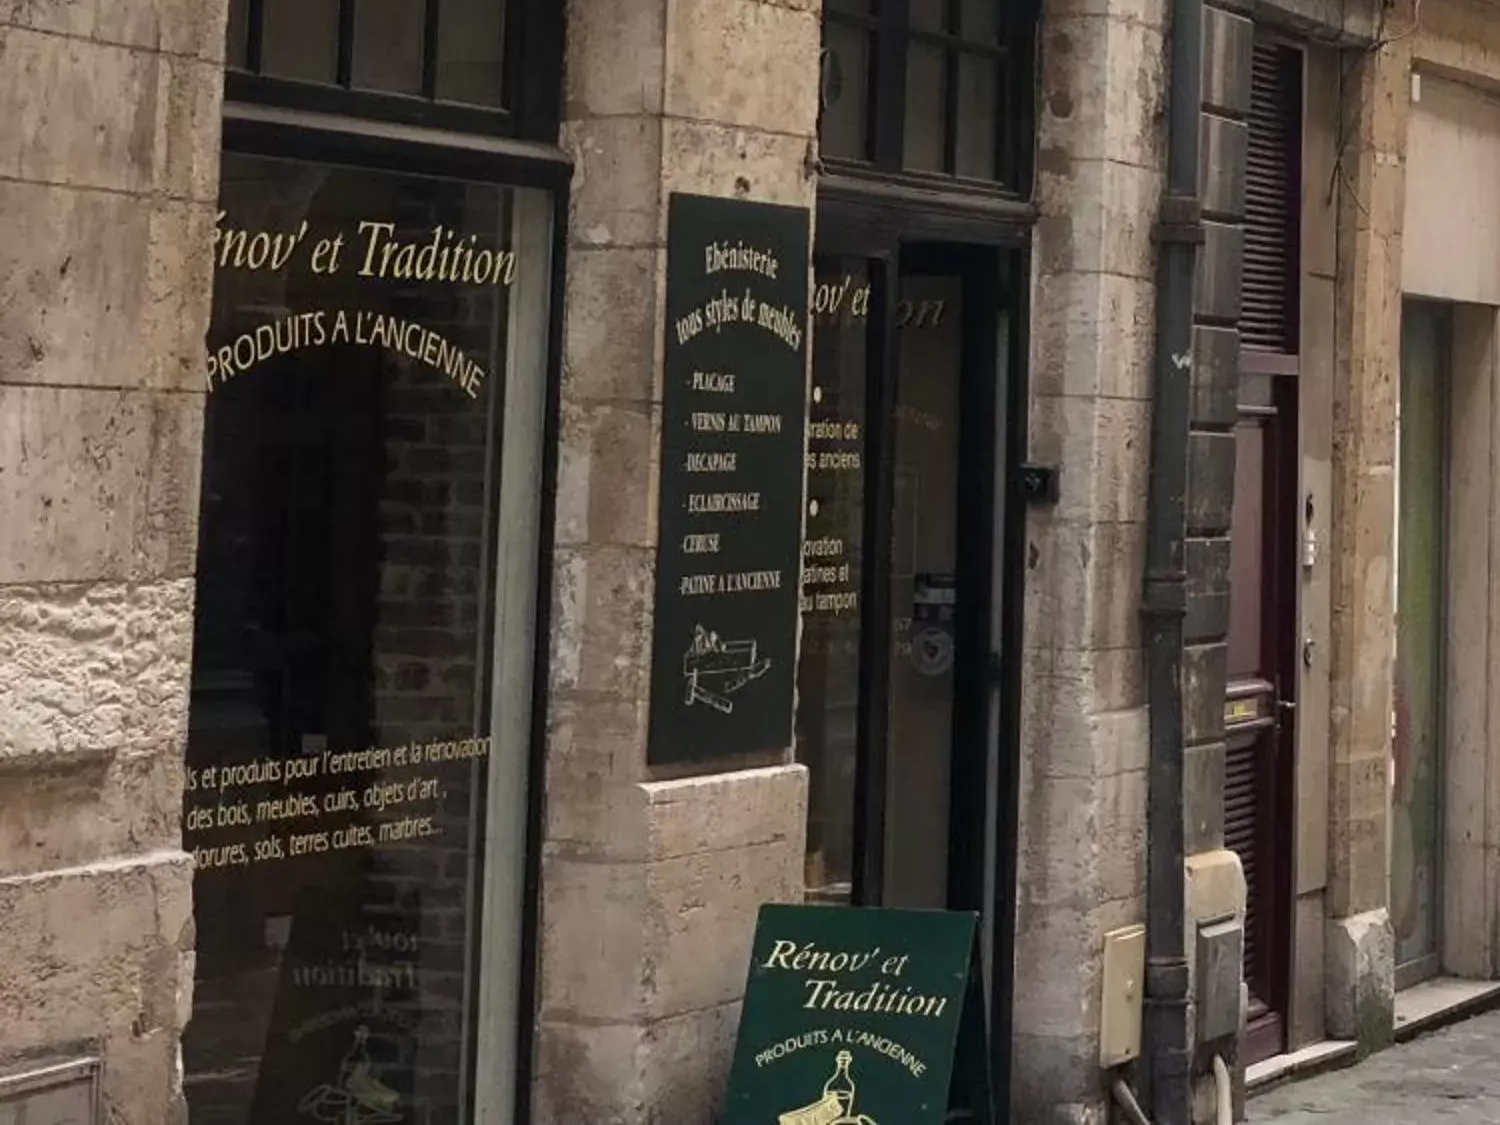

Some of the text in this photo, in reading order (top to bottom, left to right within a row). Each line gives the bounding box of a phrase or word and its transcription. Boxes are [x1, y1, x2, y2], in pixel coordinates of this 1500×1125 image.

[311, 232, 343, 274] et
[357, 220, 517, 286] Tradition
[675, 288, 801, 352] tous styles de meubles
[852, 283, 870, 316] et
[206, 310, 485, 400] PRODUITS A L'ANCIENNE
[743, 413, 782, 433] TAMPON
[815, 592, 857, 616] tampon
[201, 765, 217, 788] et
[219, 756, 282, 794] produits
[283, 755, 321, 785] pour
[393, 743, 408, 766] et
[409, 739, 422, 764] la
[187, 804, 214, 831] des
[217, 798, 253, 826] bois,
[255, 794, 319, 822] meubles,
[323, 786, 360, 812] cuirs,
[363, 779, 407, 812] objets
[253, 834, 286, 861] sols,
[289, 829, 330, 856] terres
[760, 940, 909, 976] Rénov' et
[803, 979, 948, 1018] Tradition
[754, 1028, 928, 1078] PRODUITS A L'ANCIENNE
